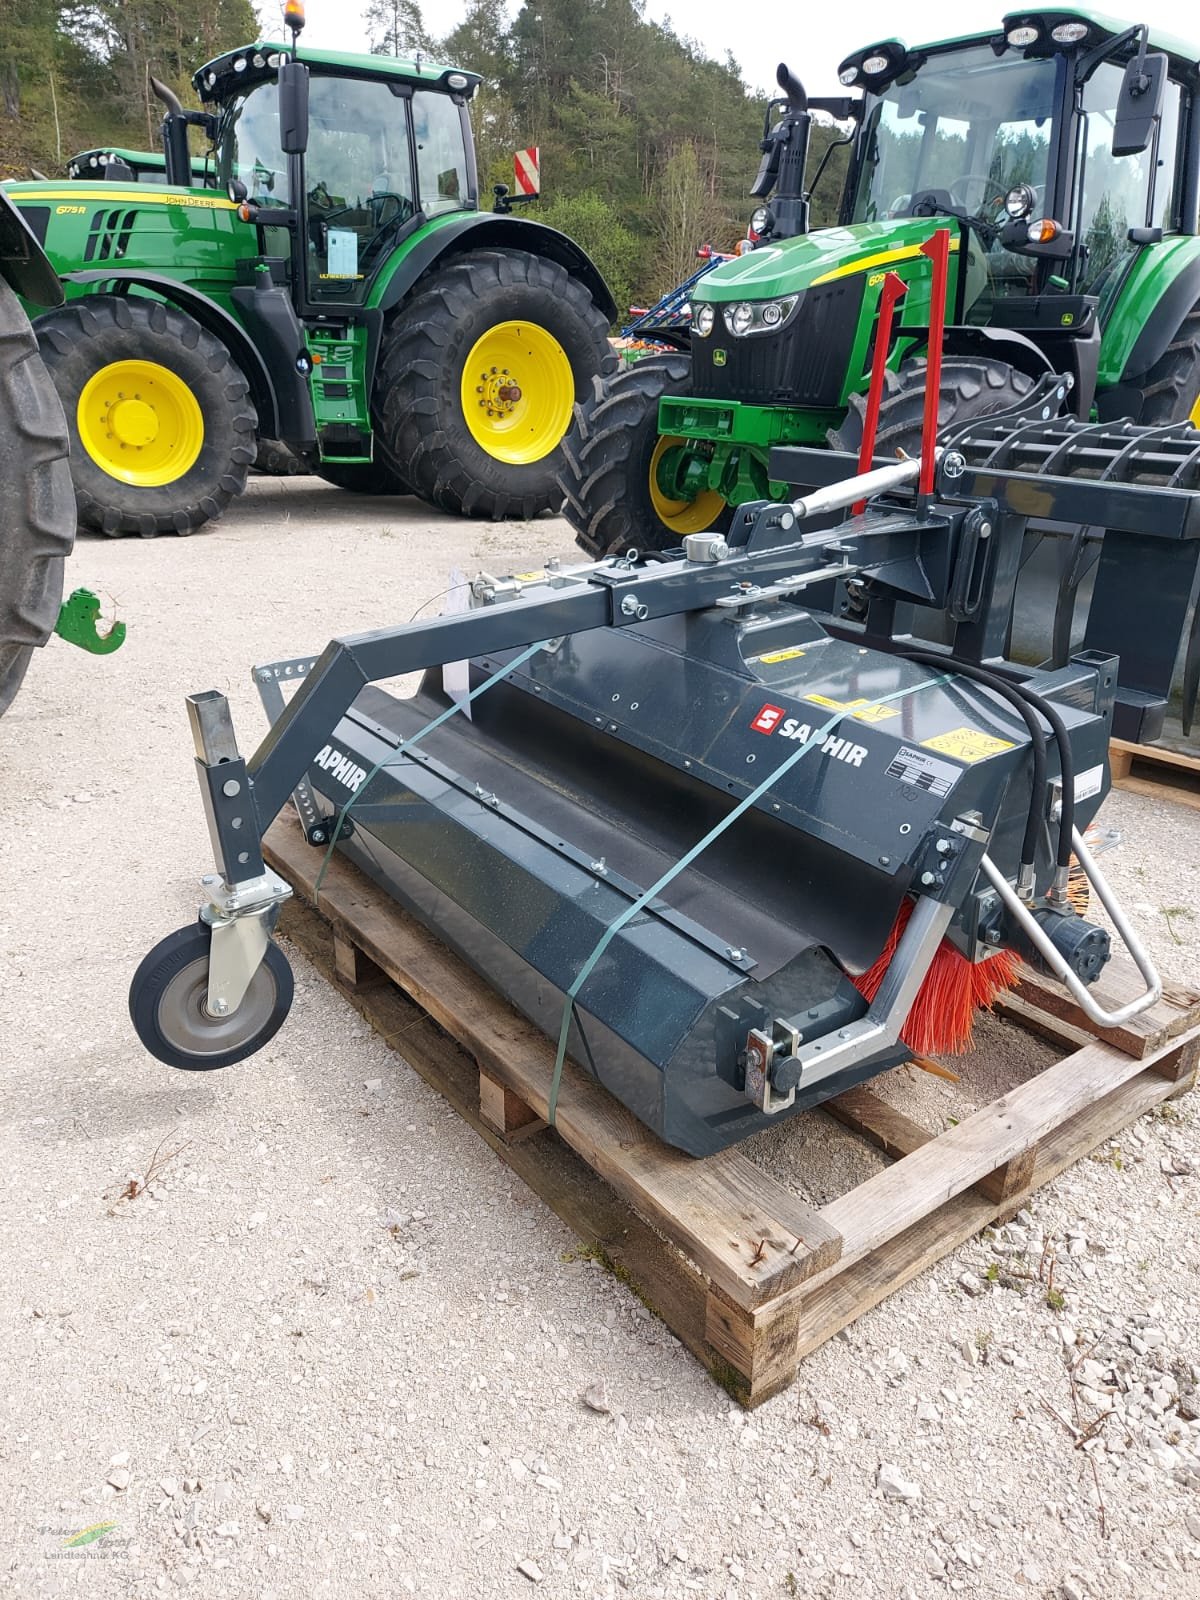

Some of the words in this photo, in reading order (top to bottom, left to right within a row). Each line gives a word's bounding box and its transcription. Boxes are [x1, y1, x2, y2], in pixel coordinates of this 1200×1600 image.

[165, 196, 187, 205] JOHN
[188, 197, 217, 207] DEERE
[313, 744, 367, 793] APHIR
